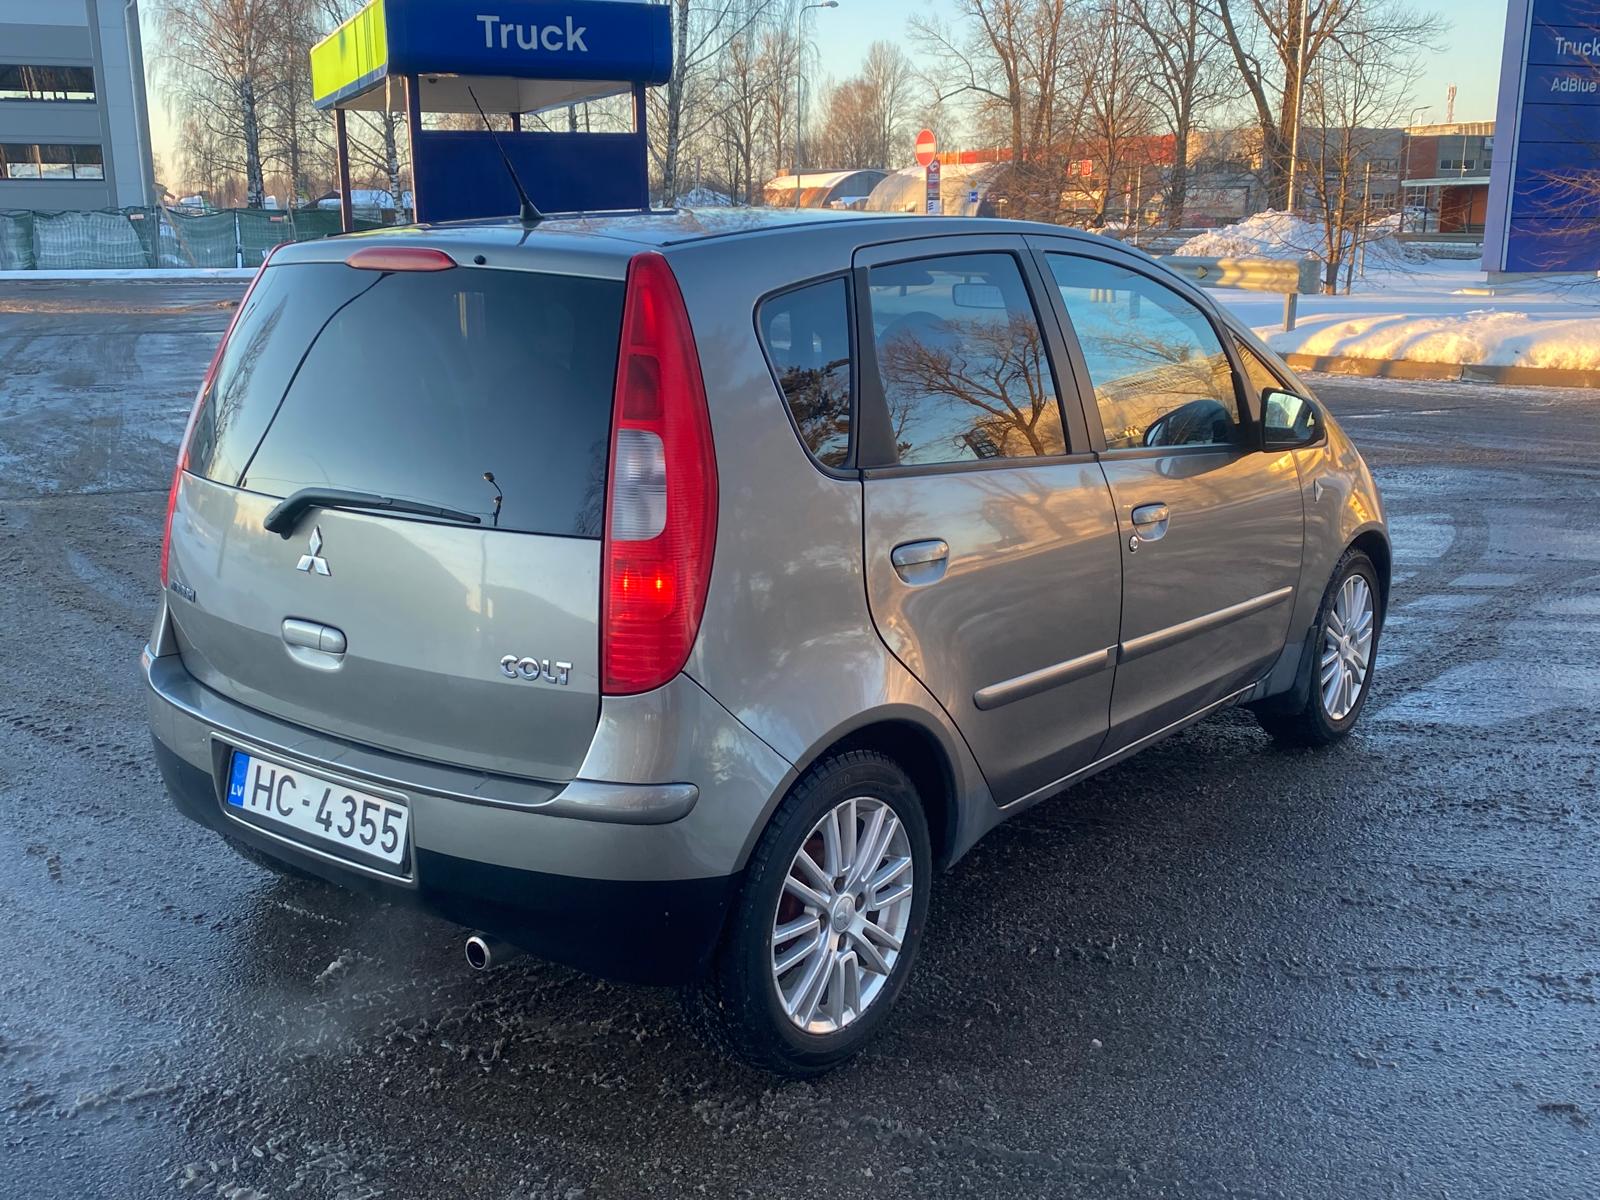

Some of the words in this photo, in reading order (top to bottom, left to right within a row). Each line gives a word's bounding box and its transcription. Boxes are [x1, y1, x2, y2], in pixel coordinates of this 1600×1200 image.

[476, 14, 588, 52] Truck
[1556, 37, 1600, 56] Truck
[1551, 77, 1597, 93] AdBlue
[500, 654, 573, 686] COLT
[230, 783, 244, 797] LV
[250, 765, 403, 854] HC-4355
